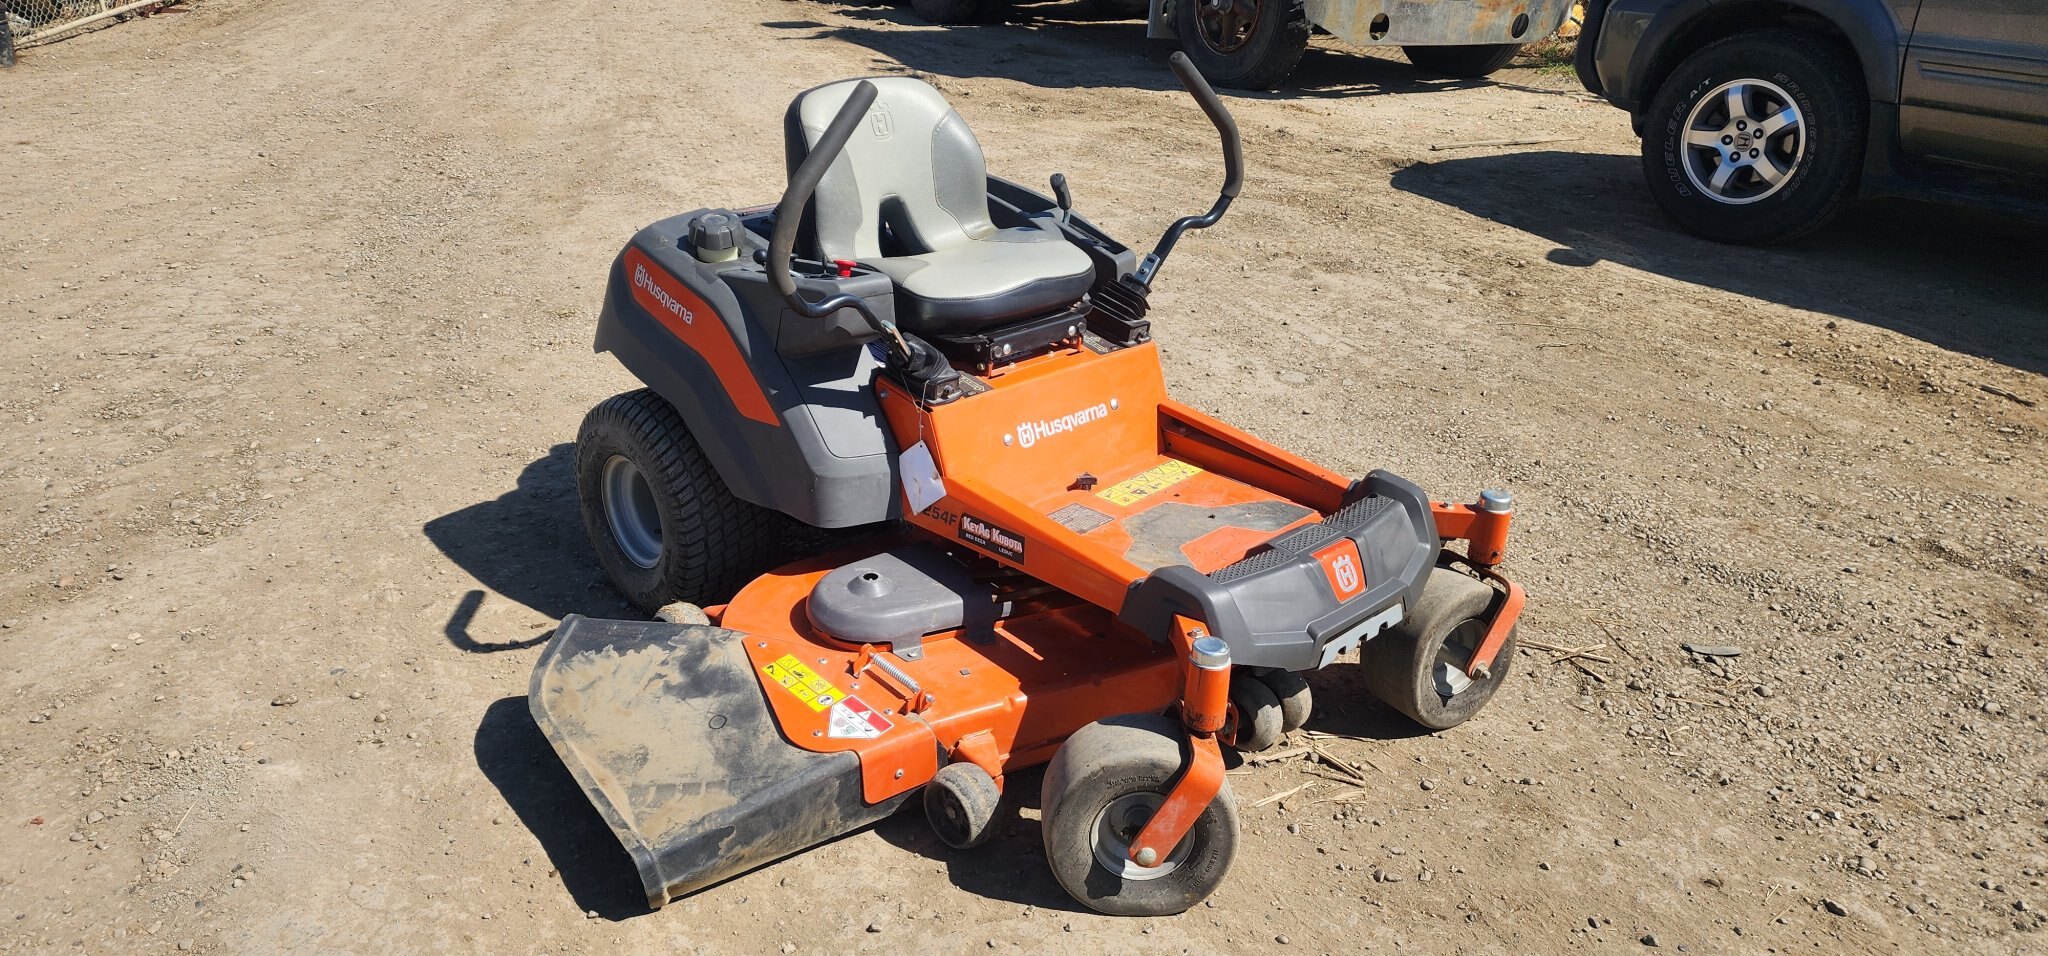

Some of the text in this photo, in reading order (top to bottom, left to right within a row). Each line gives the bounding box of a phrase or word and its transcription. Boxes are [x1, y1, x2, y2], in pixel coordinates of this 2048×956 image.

[1664, 77, 1712, 197] DUELER A/T
[643, 272, 694, 326] Husqvarna
[1033, 402, 1108, 441] Husqvarna
[998, 546, 1014, 557] LEDUC
